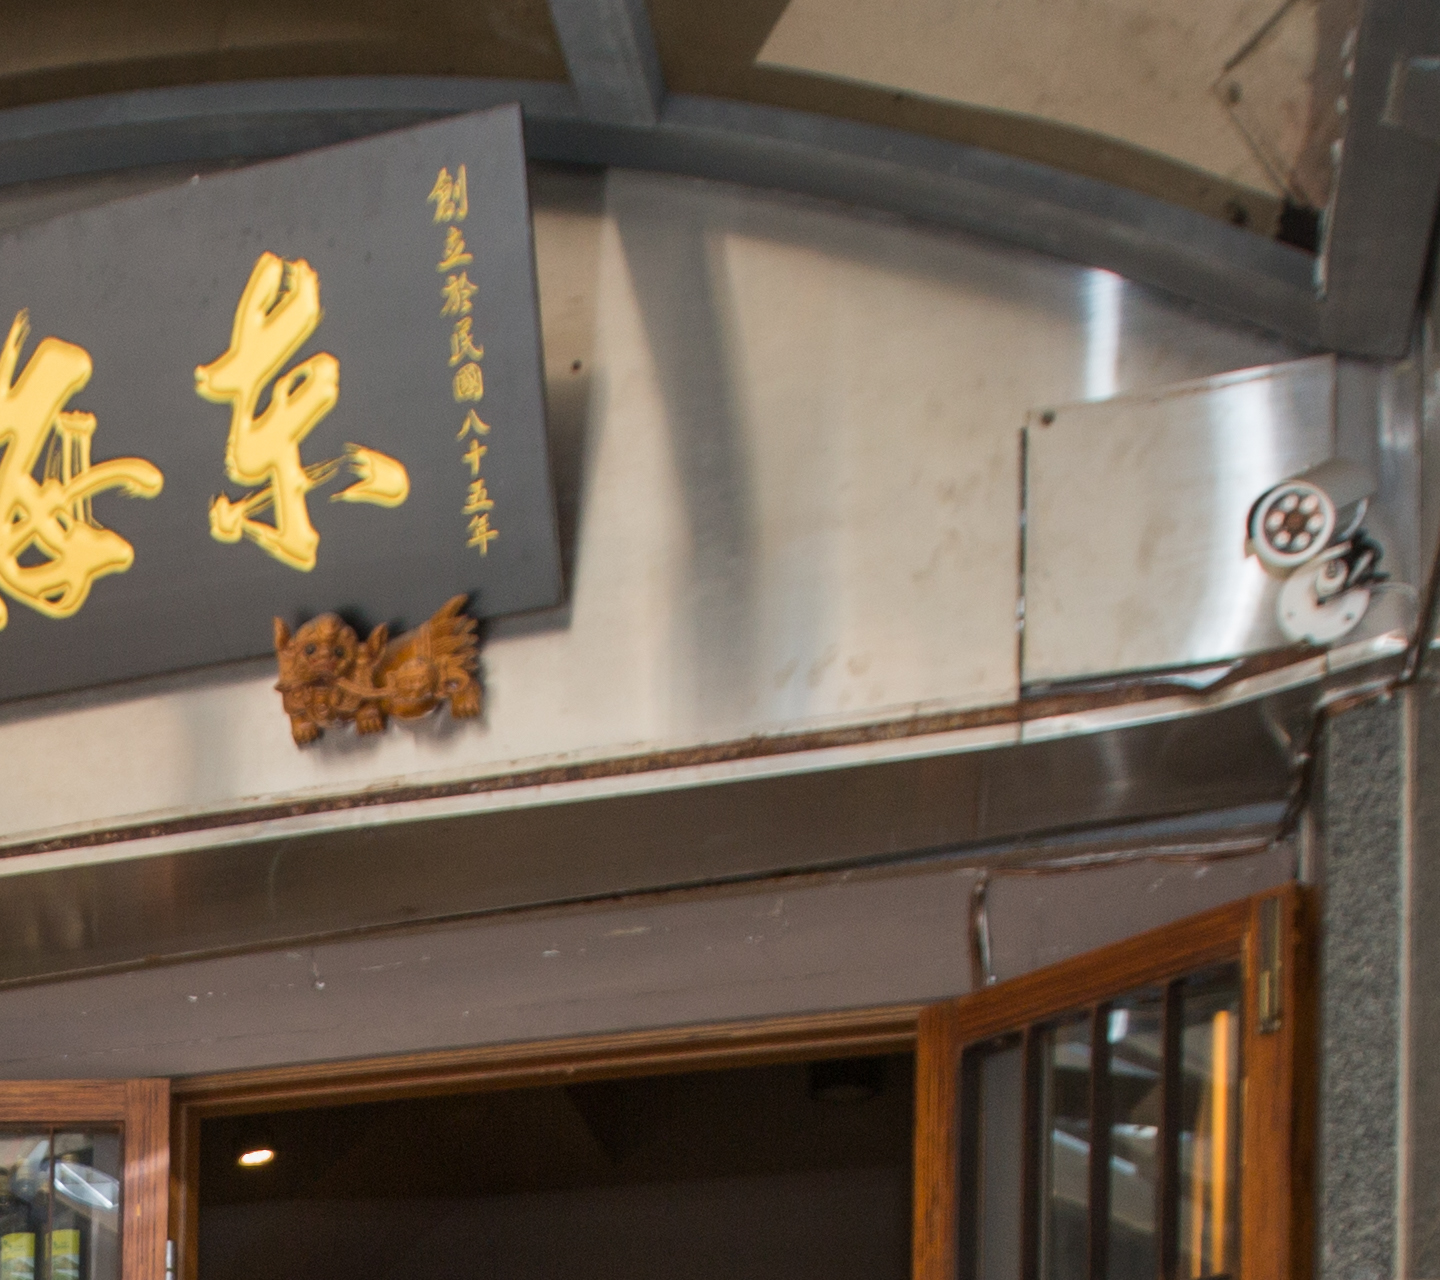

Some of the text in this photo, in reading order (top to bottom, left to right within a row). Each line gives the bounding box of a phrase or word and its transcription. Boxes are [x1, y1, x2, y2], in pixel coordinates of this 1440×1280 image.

[427, 164, 499, 557] 創立於民國八十五年
